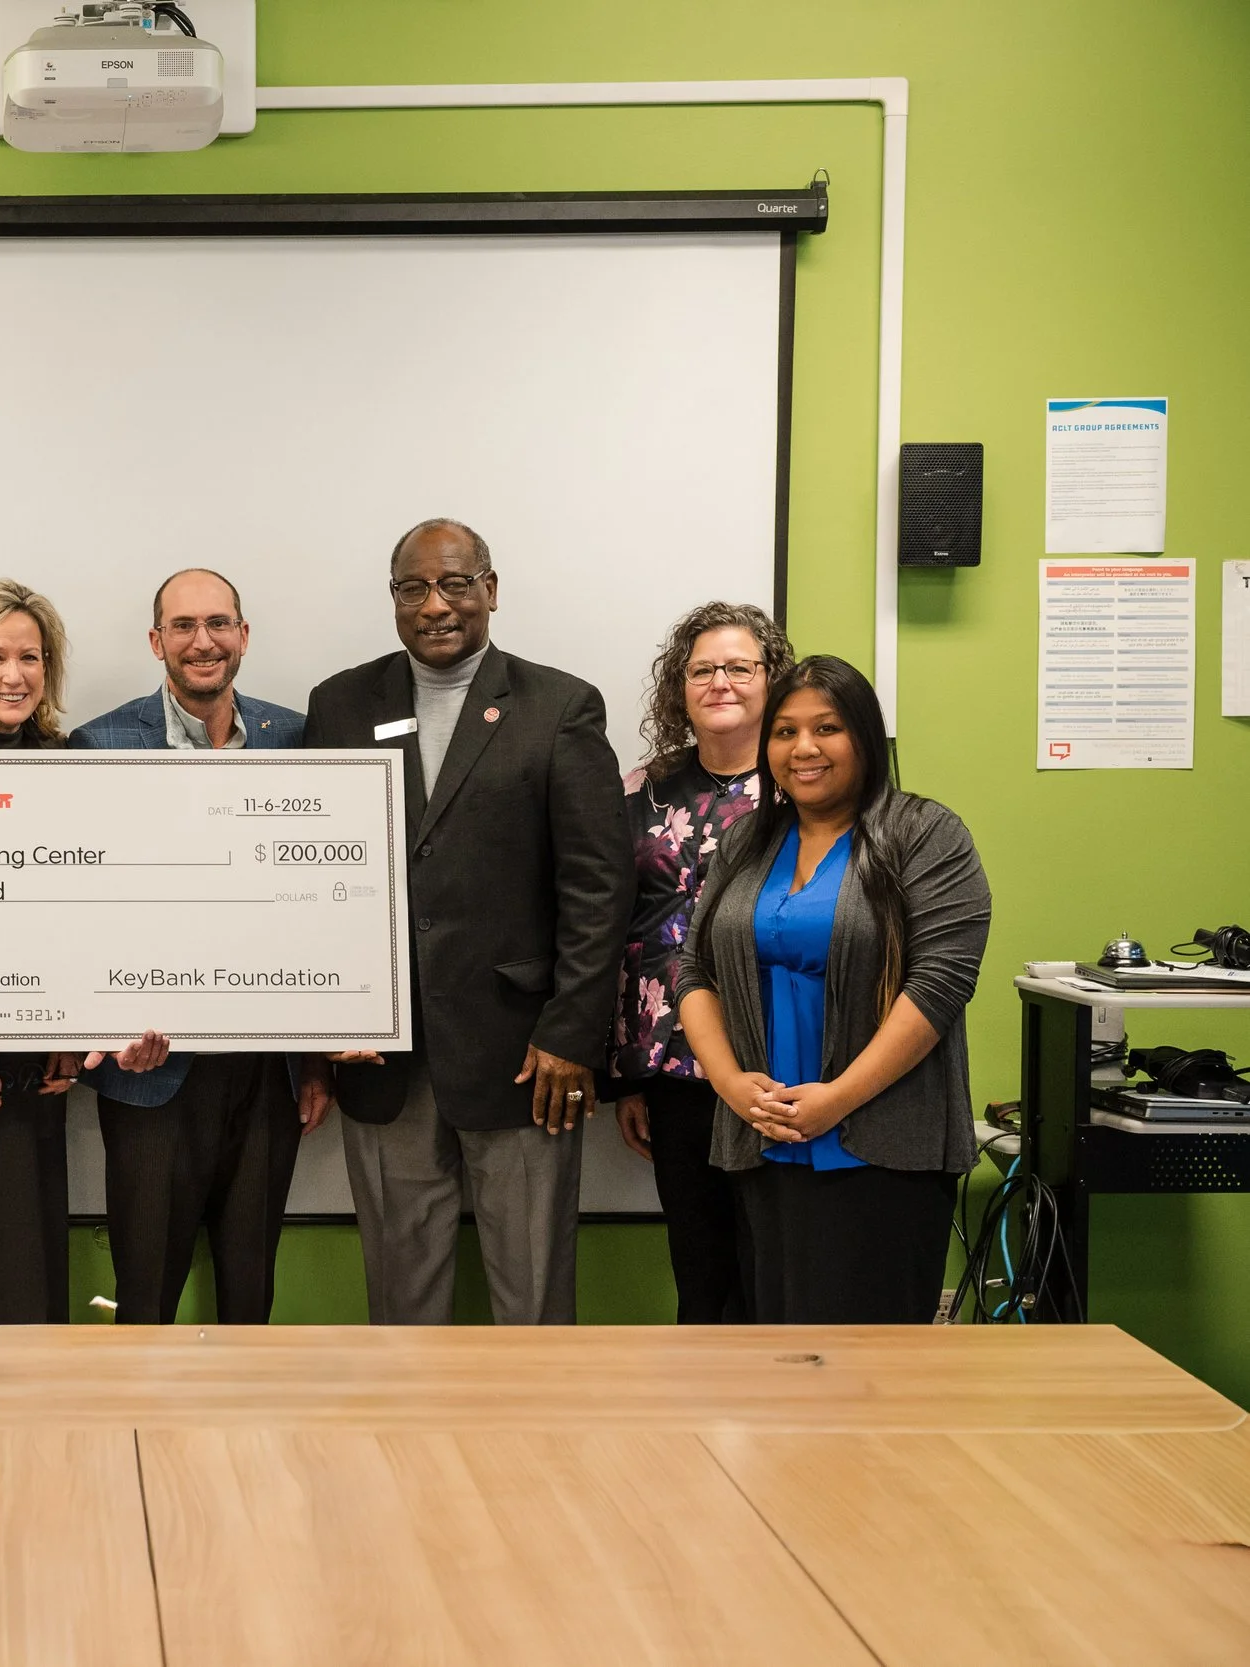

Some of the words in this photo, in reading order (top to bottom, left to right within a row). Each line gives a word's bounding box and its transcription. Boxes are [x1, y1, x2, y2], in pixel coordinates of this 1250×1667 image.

[102, 61, 133, 69] EPSON
[757, 203, 798, 213] Quartet
[1104, 423, 1160, 431] AGREEMENTS
[208, 807, 233, 815] DATE
[244, 798, 321, 812] 11-6-2025
[33, 846, 106, 863] Center
[255, 843, 266, 863] $
[278, 844, 363, 863] 200,000
[276, 893, 318, 902] DOLLARS
[109, 968, 205, 989] KeyBank
[214, 968, 339, 986] Foundation
